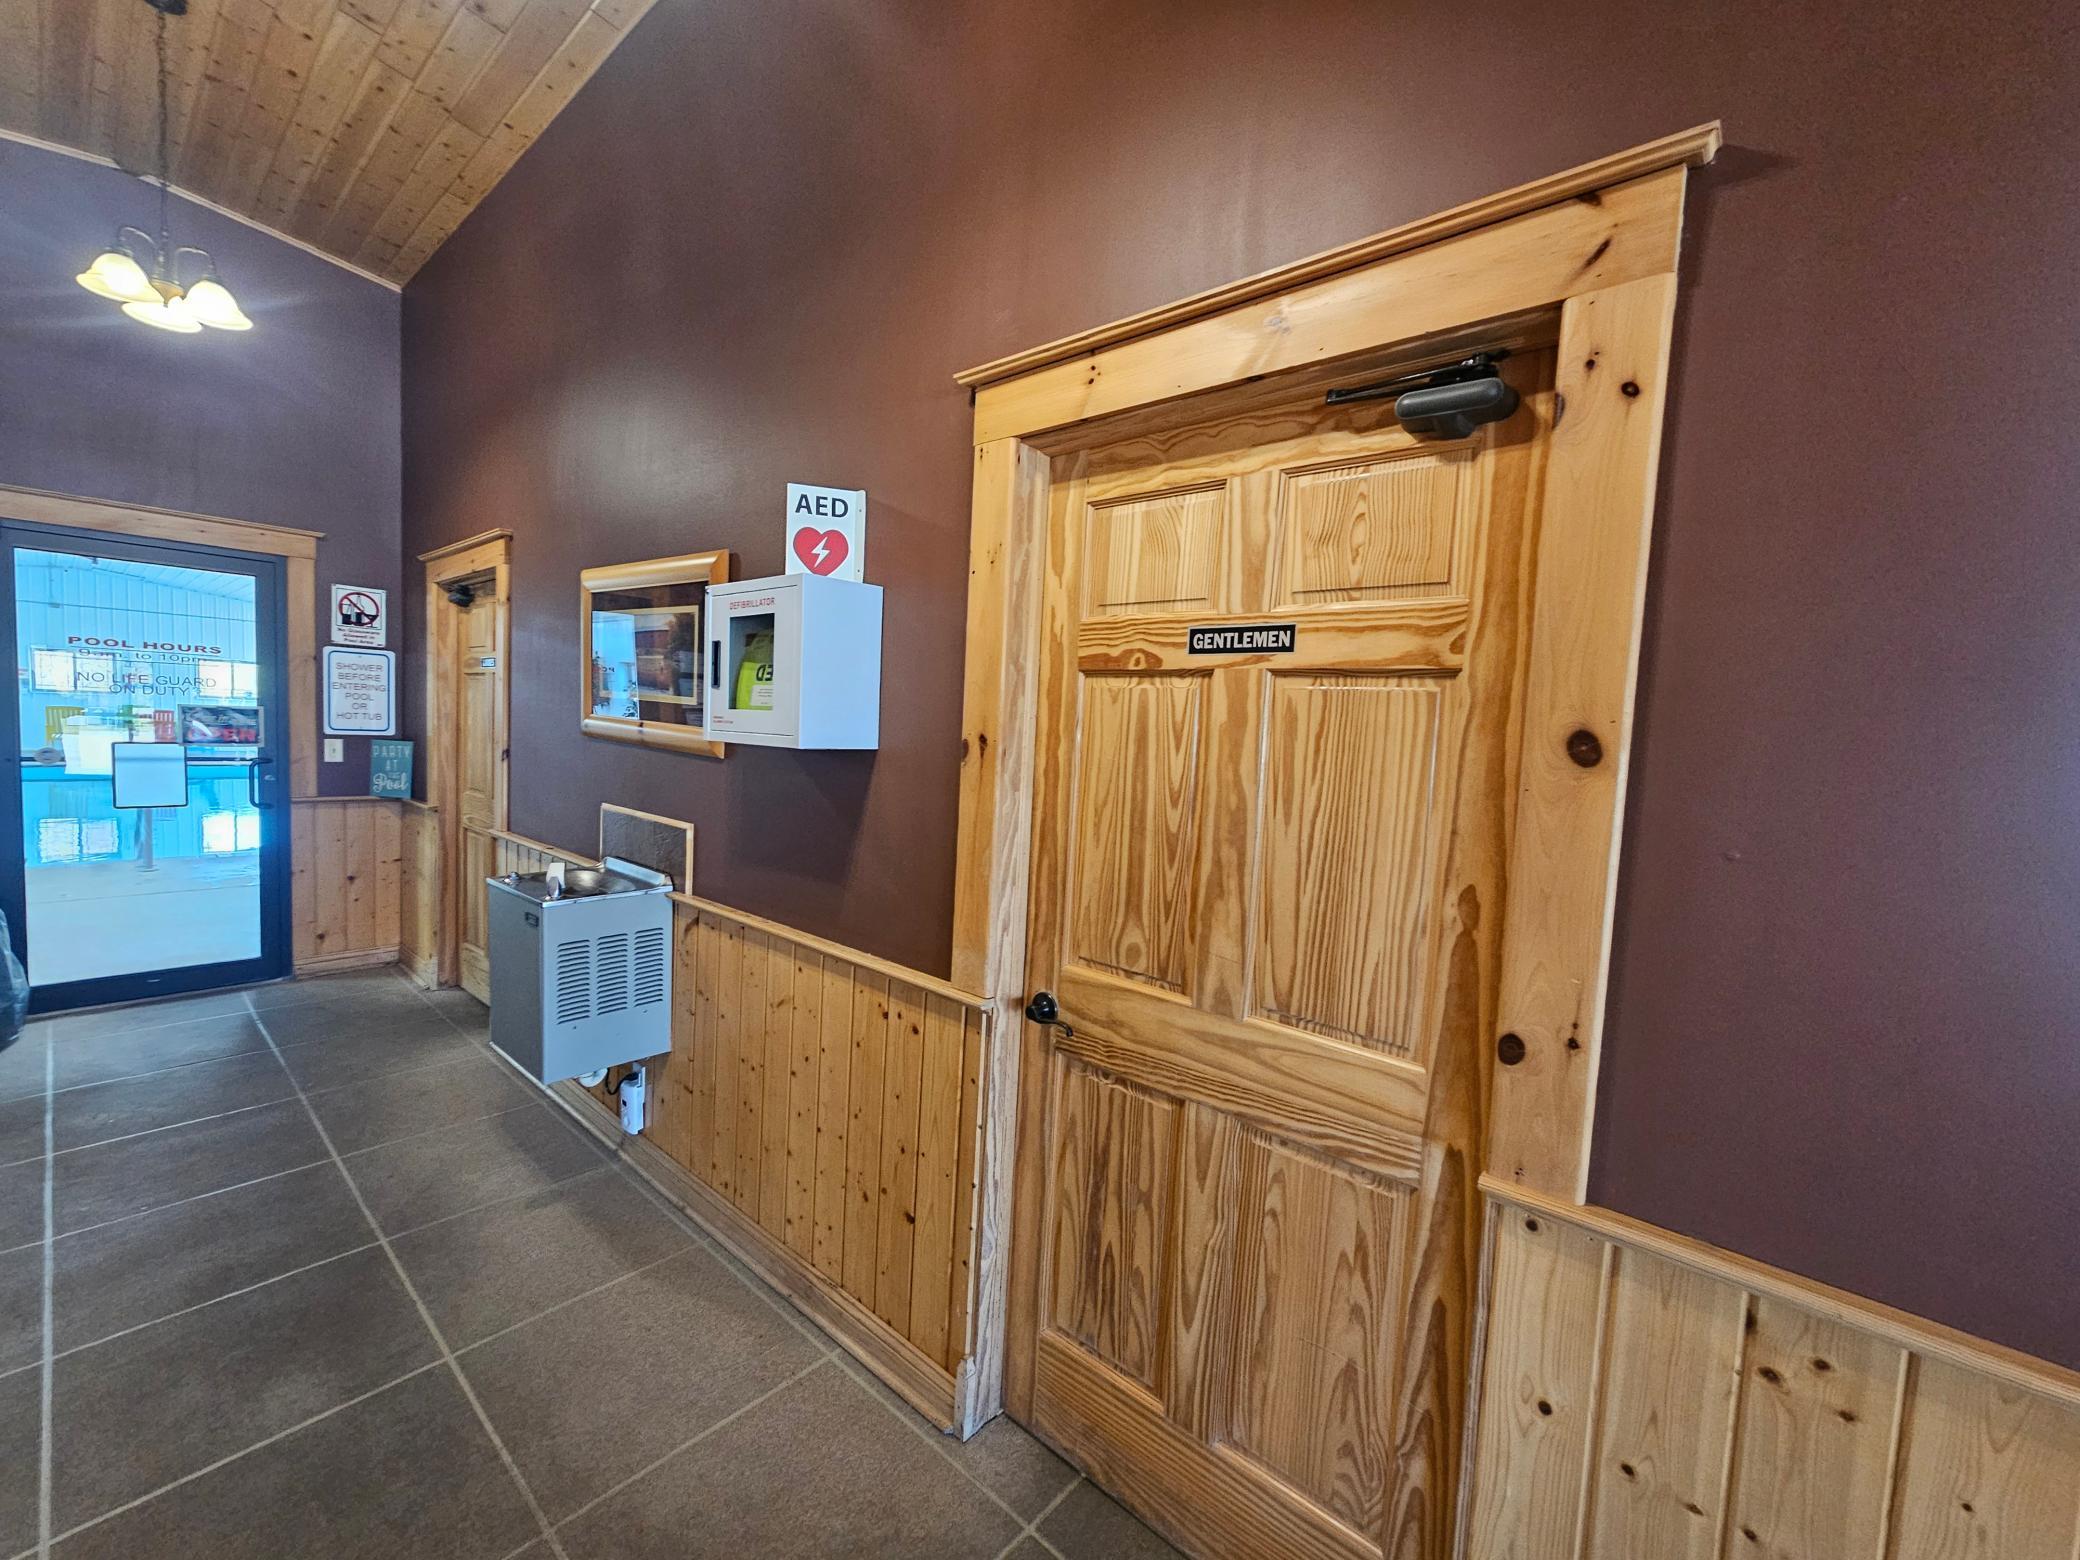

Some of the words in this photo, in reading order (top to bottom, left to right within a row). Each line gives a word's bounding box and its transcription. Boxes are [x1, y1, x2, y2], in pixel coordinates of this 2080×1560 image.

[795, 493, 849, 518] AED
[729, 597, 775, 610] DEFIBRILLATOR
[1193, 630, 1291, 649] GENTLEMEN
[68, 636, 134, 648] POOL
[143, 641, 221, 654] HOURS
[136, 652, 152, 660] to
[336, 662, 383, 672] SHOWER
[77, 672, 105, 682] NO
[112, 673, 150, 685] LIFE
[155, 675, 217, 688] GUARD
[338, 672, 381, 682] BEFORE
[109, 684, 136, 694] ON
[143, 685, 189, 696] DUTY
[333, 682, 385, 692] ENTERING
[345, 692, 374, 701] POOL
[352, 702, 368, 711] OR
[336, 711, 360, 720] HOT
[361, 712, 382, 721] TUB
